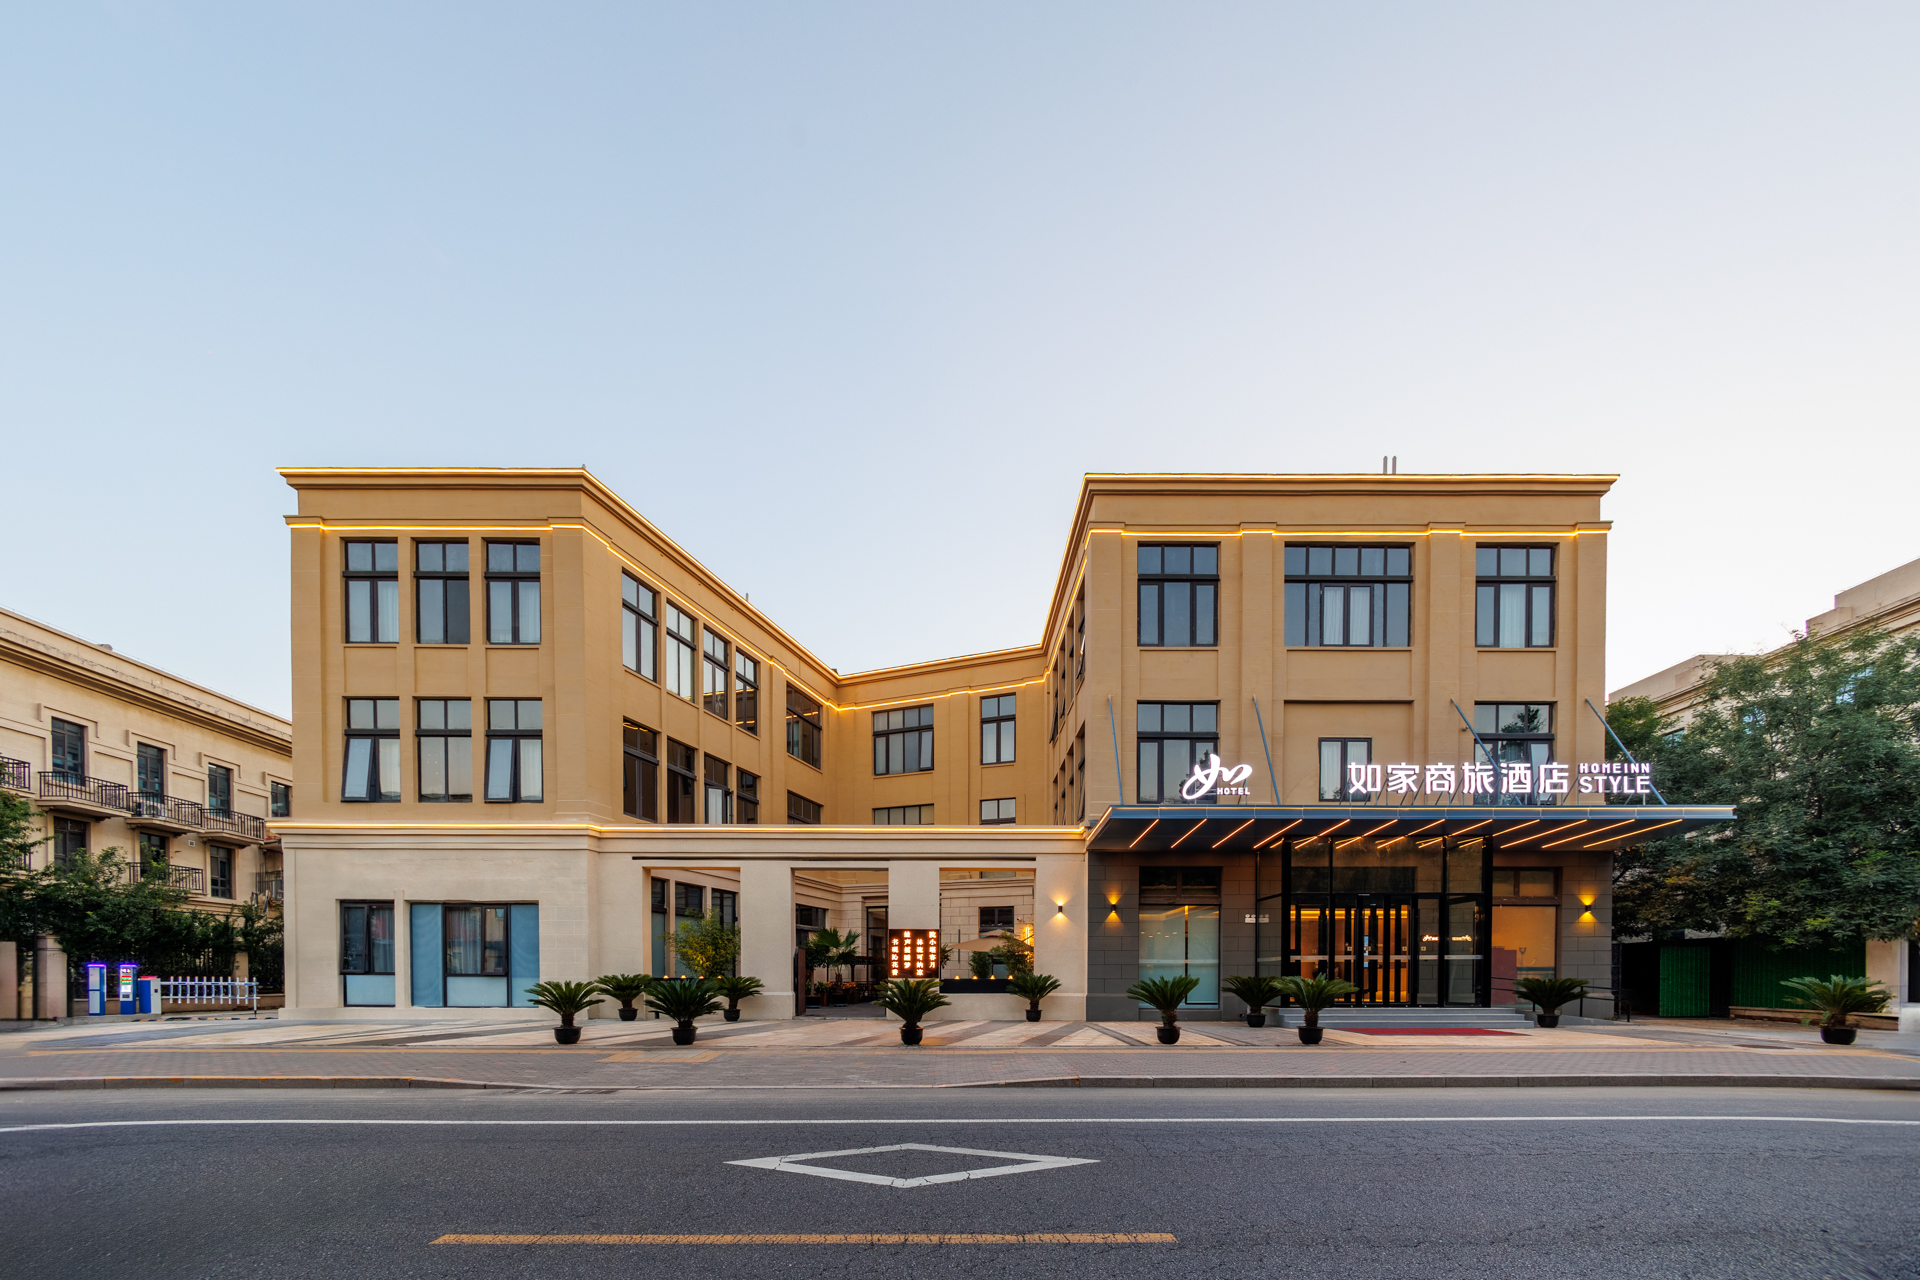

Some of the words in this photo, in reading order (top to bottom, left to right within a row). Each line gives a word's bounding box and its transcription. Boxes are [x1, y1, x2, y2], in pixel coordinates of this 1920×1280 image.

[1347, 762, 1569, 794] 如家商旅酒店
[1579, 776, 1650, 794] STYLE
[1217, 787, 1250, 795] HOTEL
